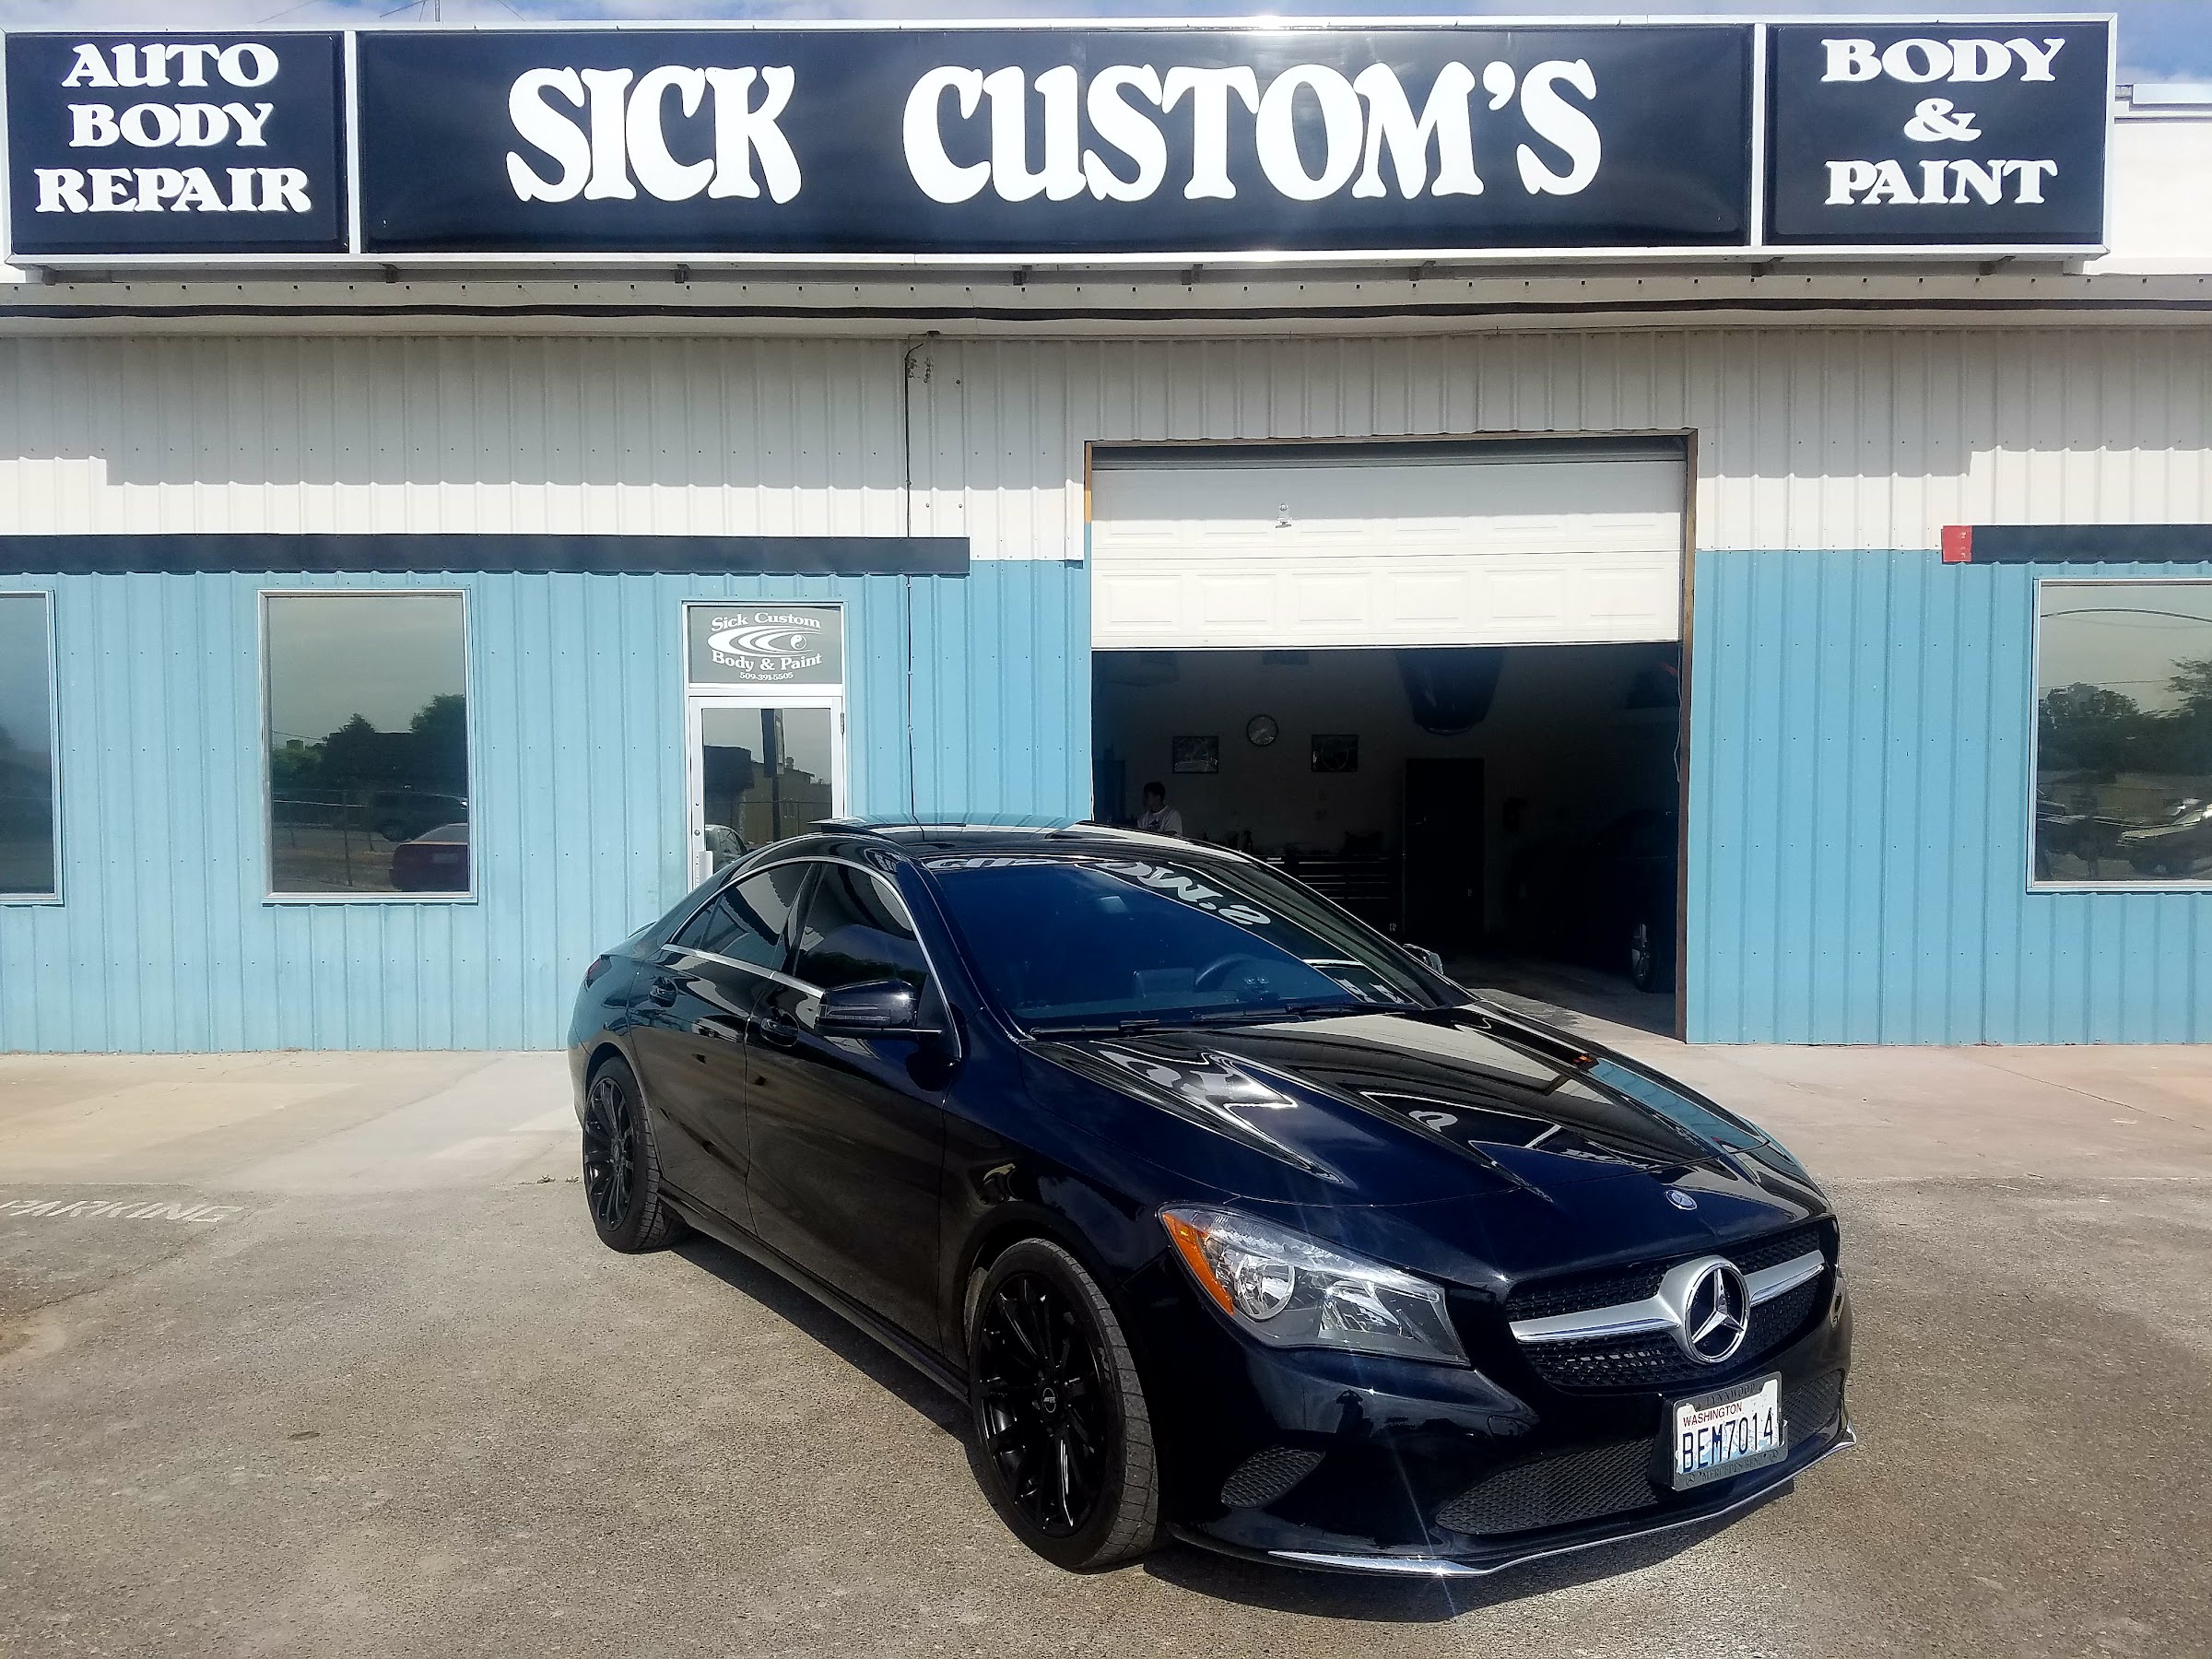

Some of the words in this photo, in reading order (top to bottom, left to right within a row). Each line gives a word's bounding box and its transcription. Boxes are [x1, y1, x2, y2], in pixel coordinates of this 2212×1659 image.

[62, 43, 278, 88] AUTO
[1821, 38, 2065, 83] BODY
[67, 102, 274, 147] BODY
[506, 65, 802, 204] SICK
[902, 59, 1601, 204] CUSTOM'S
[1903, 98, 1983, 143] &
[34, 167, 312, 214] REPAIR
[1825, 159, 2058, 206] PAINT
[711, 613, 748, 631] Sick
[754, 612, 821, 629] Custom
[712, 650, 754, 672] Body
[759, 657, 775, 671] &
[781, 653, 822, 671] Paint
[1683, 1402, 1743, 1428] WASHINGTON
[1682, 1406, 1773, 1474] BEM7014
